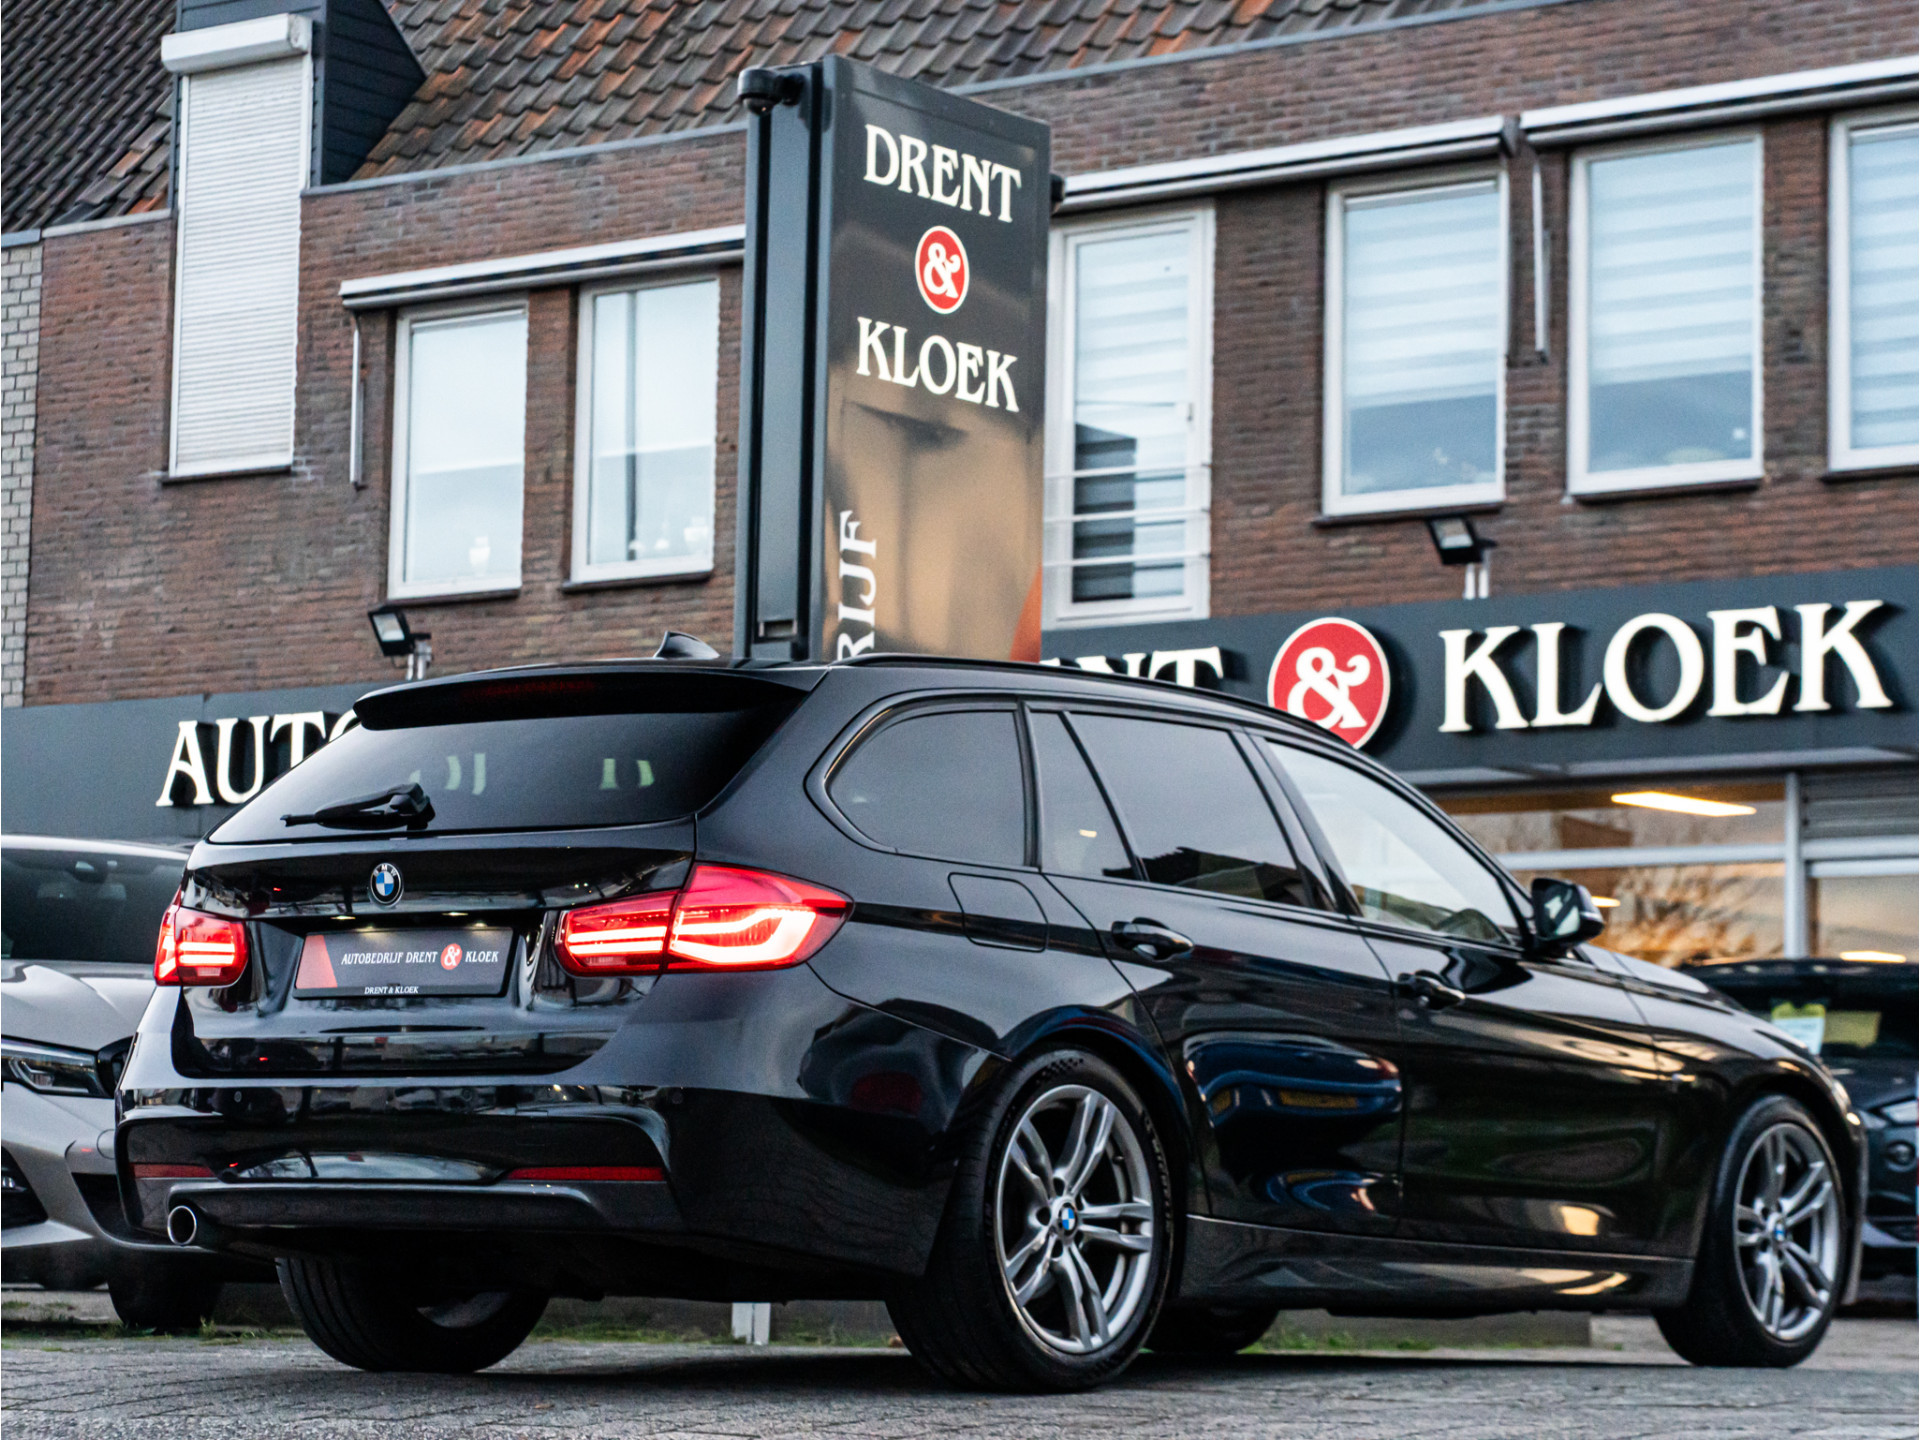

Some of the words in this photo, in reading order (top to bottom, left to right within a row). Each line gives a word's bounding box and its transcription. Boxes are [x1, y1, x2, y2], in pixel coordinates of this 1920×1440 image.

[863, 123, 1022, 223] DRENT
[922, 242, 962, 299] &
[856, 316, 1020, 413] KLOEK
[1286, 646, 1370, 728] &
[1438, 598, 1893, 733] KLOEK
[155, 709, 357, 807] AUT
[341, 952, 403, 965] AUTOBEDRIJF
[405, 951, 438, 964] DRENT
[444, 946, 460, 967] &
[465, 950, 499, 963] KLOEK
[364, 986, 387, 995] DRENT
[387, 987, 394, 995] &
[394, 985, 419, 994] KLOEK
